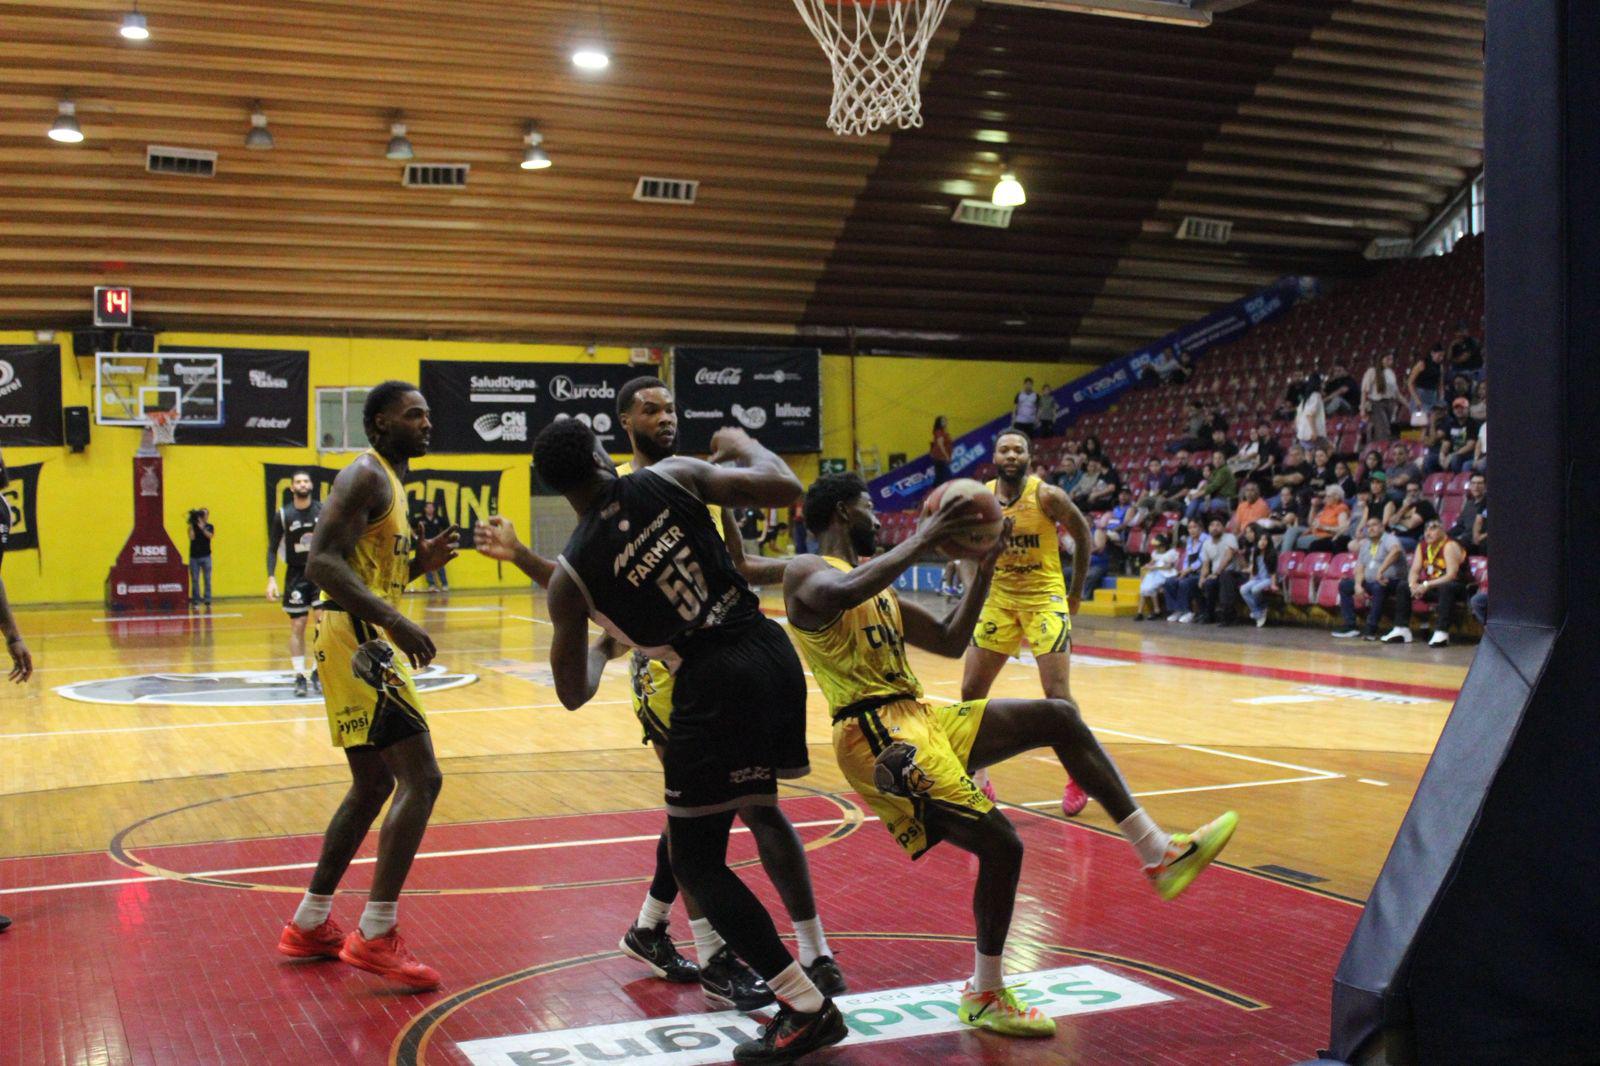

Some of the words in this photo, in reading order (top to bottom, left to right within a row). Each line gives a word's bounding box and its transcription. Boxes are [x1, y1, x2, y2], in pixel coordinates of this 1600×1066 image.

[106, 290, 127, 314] 14
[556, 379, 616, 399] Kuroda
[626, 525, 685, 588] FARMER
[656, 545, 709, 622] 55
